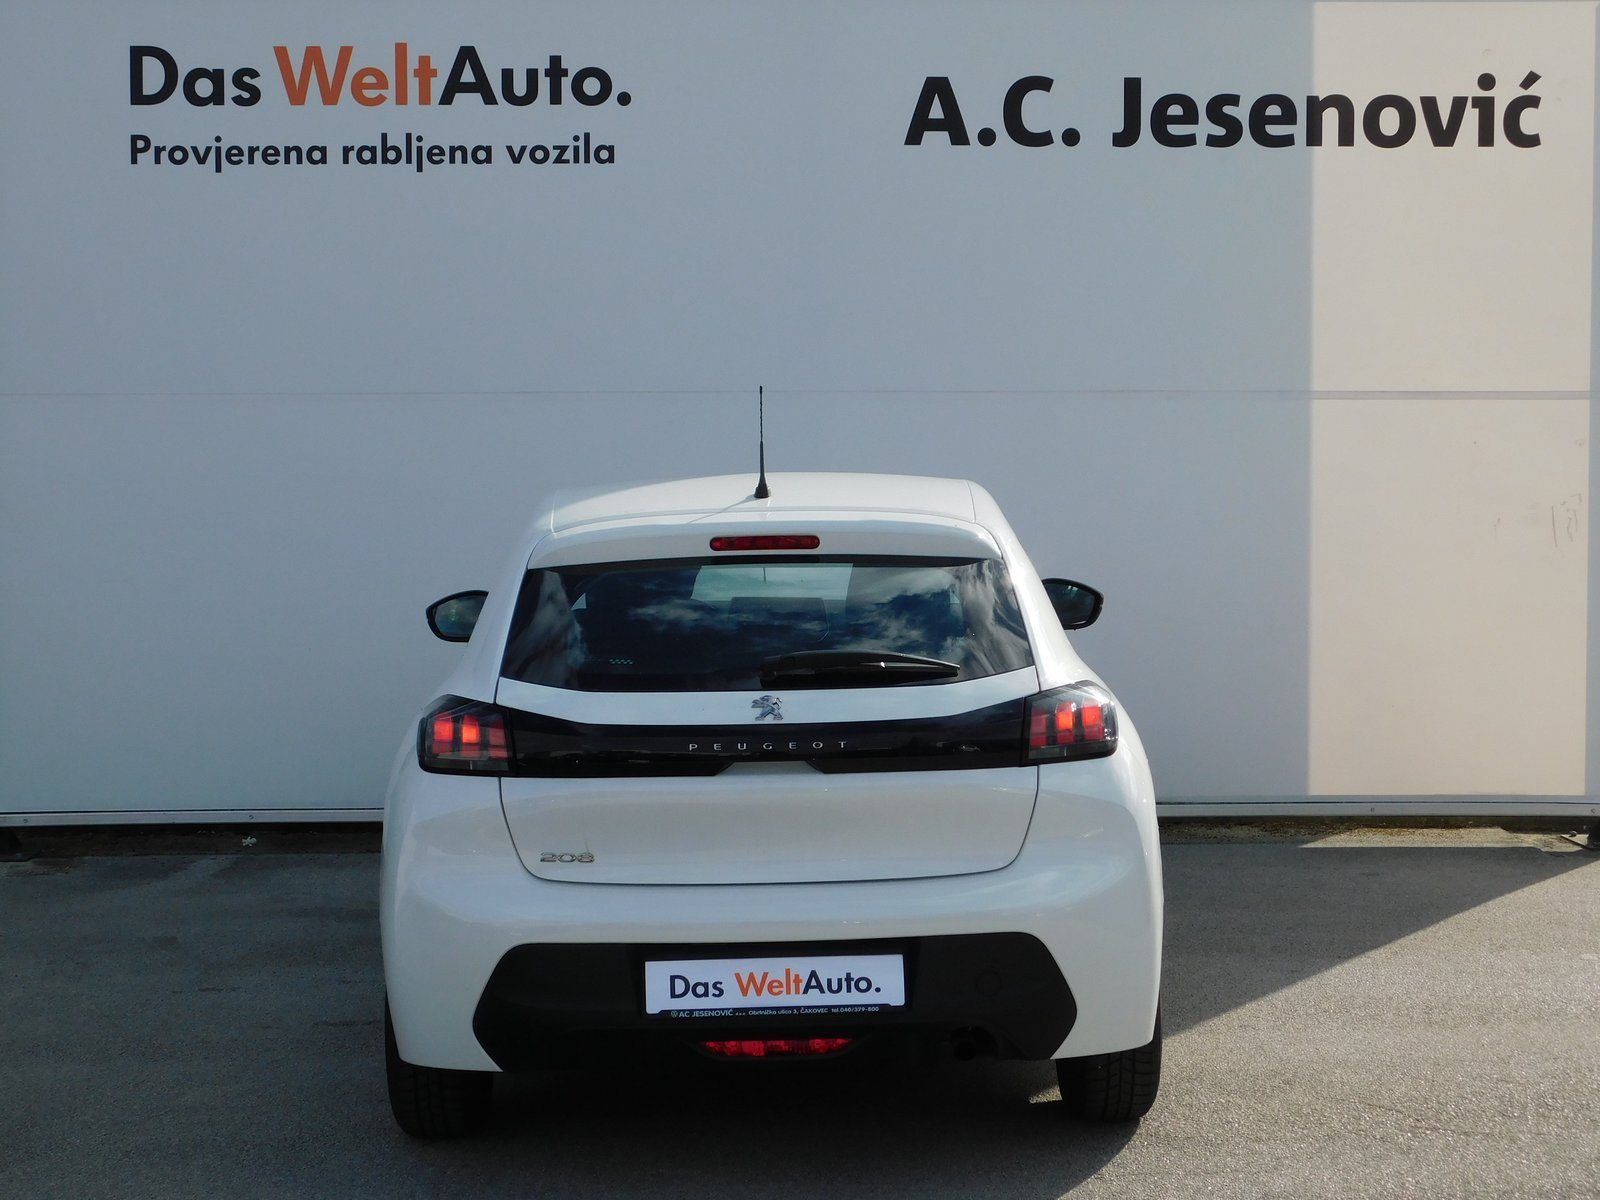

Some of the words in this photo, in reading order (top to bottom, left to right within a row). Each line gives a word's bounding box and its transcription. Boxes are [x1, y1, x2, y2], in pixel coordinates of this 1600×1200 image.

[130, 46, 261, 107] Das
[273, 42, 632, 107] WeltAuto.
[904, 75, 1081, 148] A.C.
[1112, 70, 1542, 148] Jesenović
[130, 134, 328, 173] Provjerena
[342, 133, 493, 173] rabljena
[506, 132, 615, 165] vozila
[688, 741, 847, 751] PEUGEOT
[540, 852, 595, 864] 208
[669, 974, 724, 999] Das
[735, 968, 882, 997] WeltAuto.
